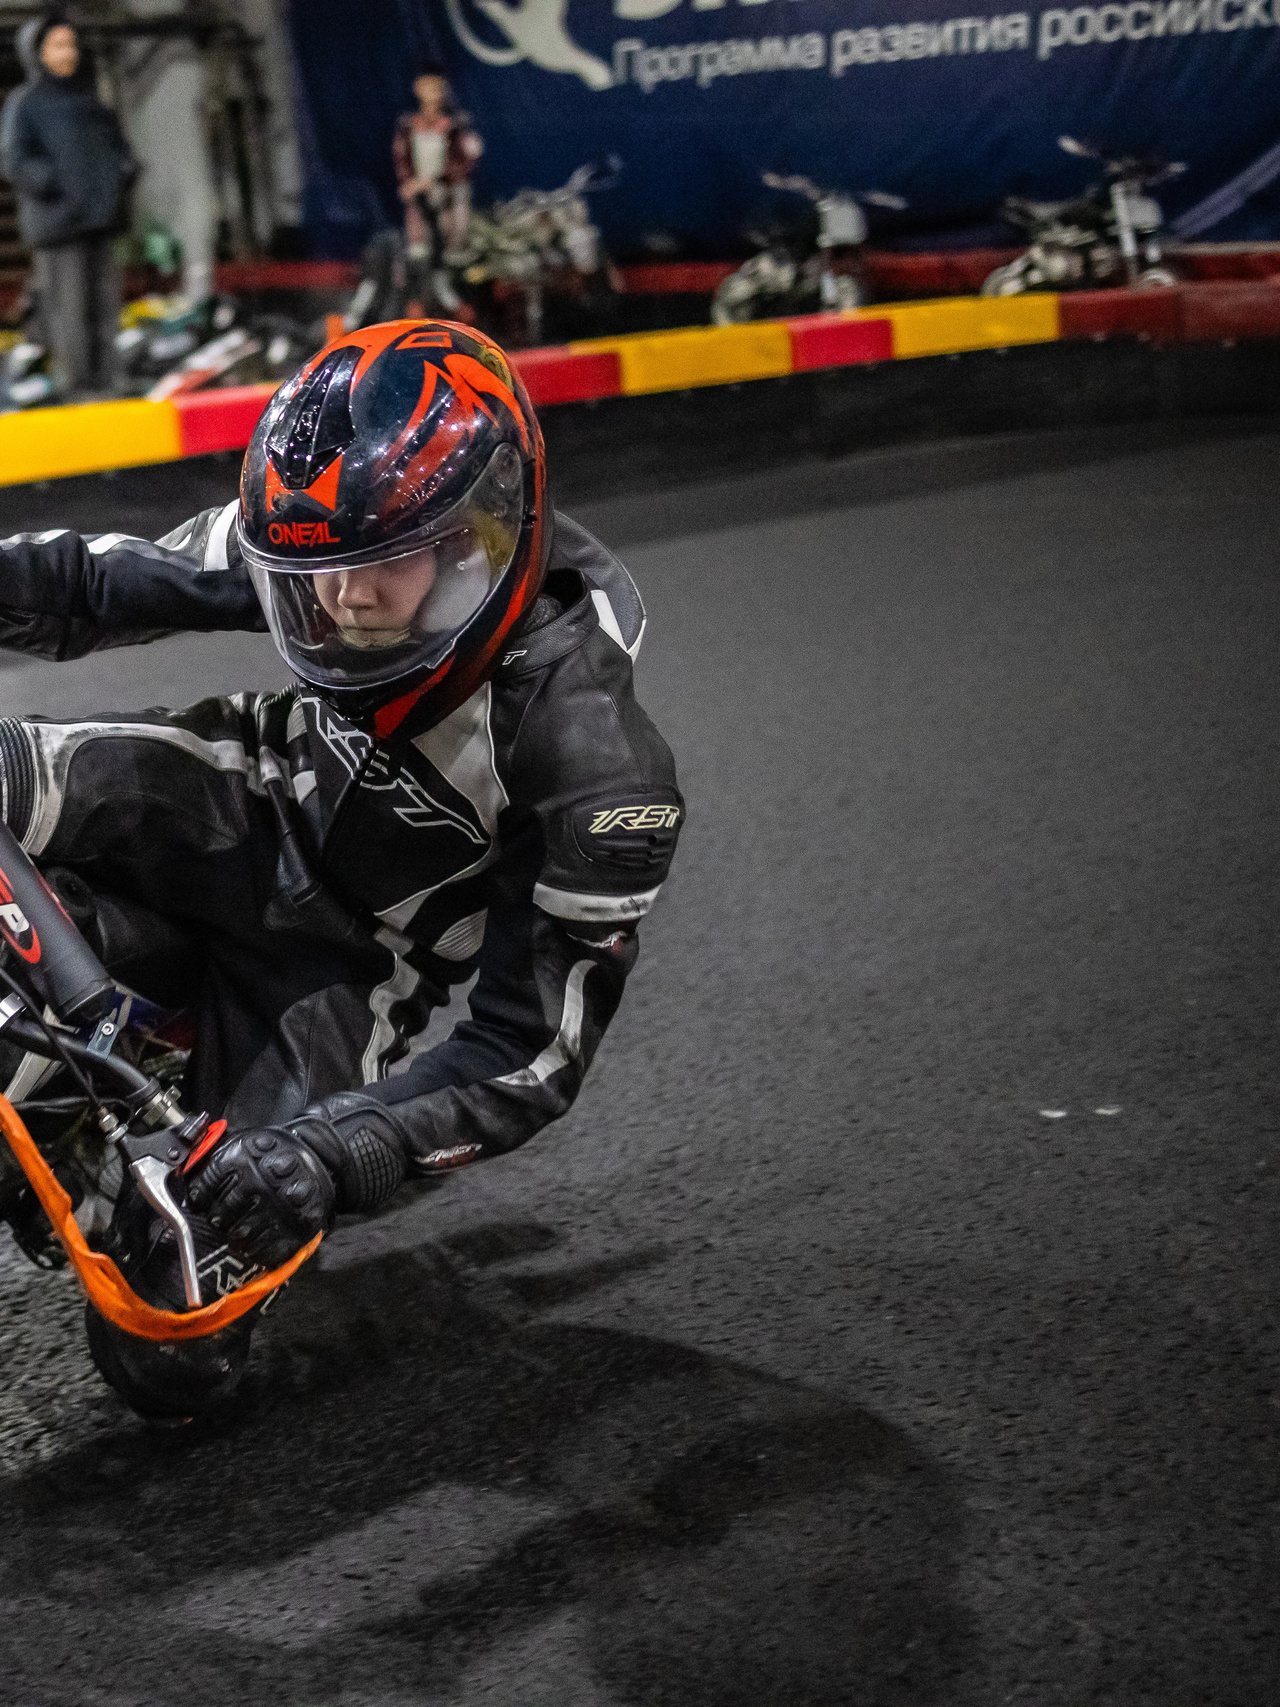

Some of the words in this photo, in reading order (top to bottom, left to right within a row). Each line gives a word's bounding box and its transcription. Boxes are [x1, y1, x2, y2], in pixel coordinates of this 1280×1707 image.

[613, 32, 825, 93] Программа
[831, 13, 1029, 77] развития
[1036, 0, 1280, 60] российск
[268, 521, 341, 548] ONEAL
